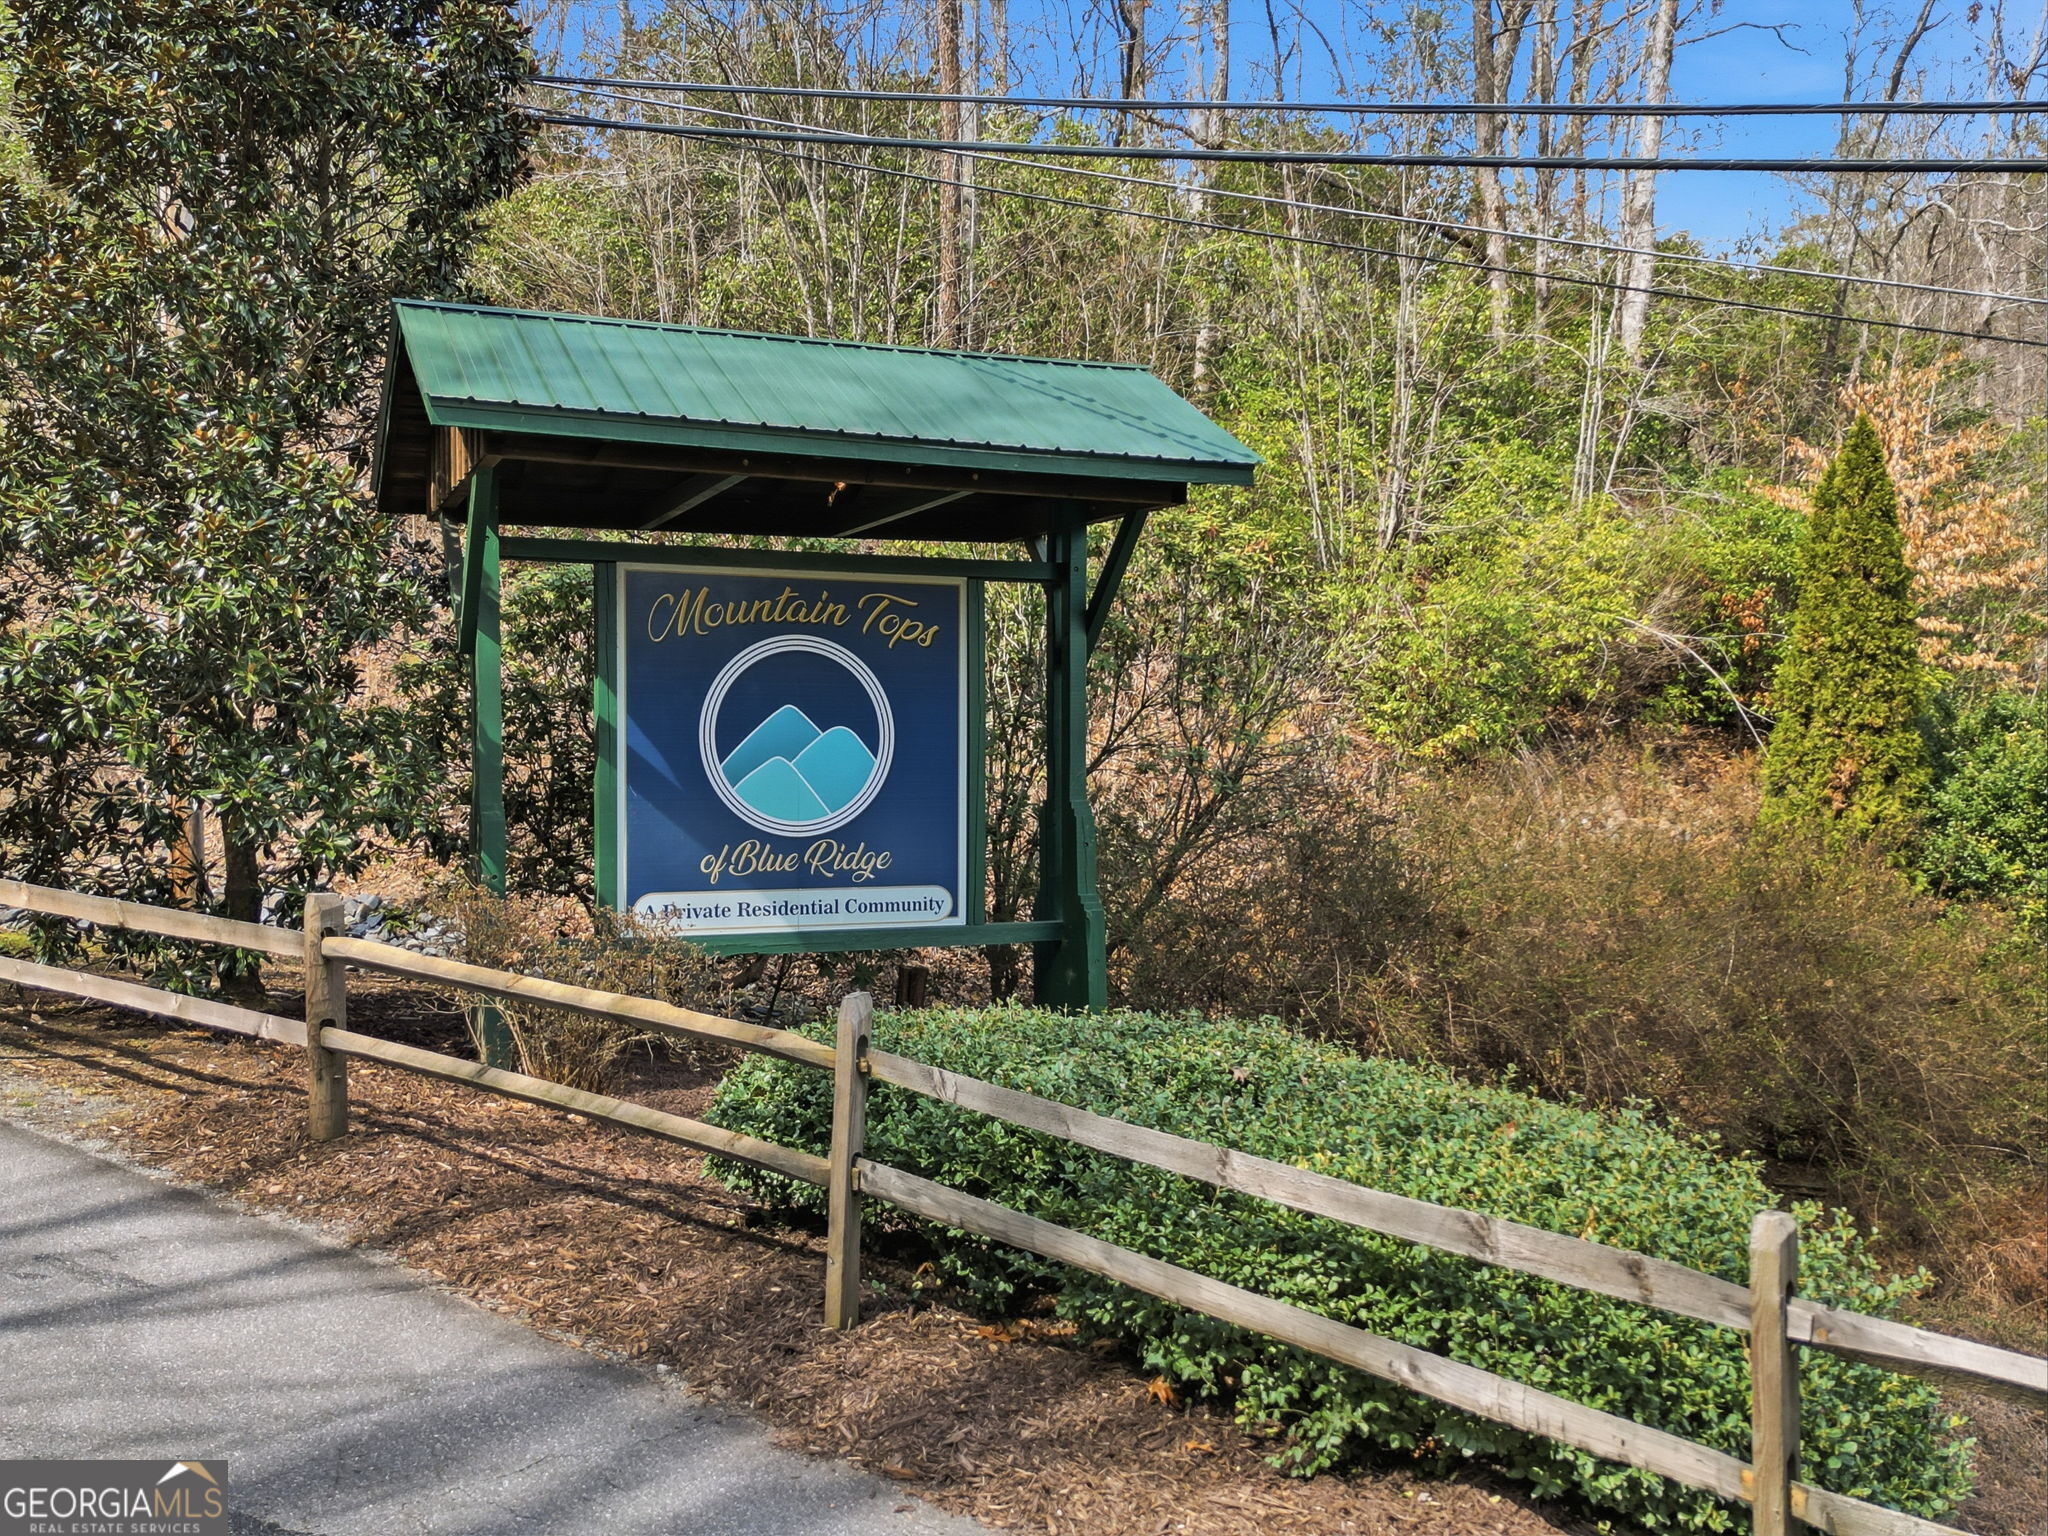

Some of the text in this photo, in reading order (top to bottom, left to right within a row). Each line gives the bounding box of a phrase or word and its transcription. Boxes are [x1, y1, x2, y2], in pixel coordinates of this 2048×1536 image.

[648, 586, 940, 649] Mountain Tops
[700, 838, 893, 885] of Blue Ridge
[736, 898, 840, 919] Residential
[844, 896, 945, 915] Community
